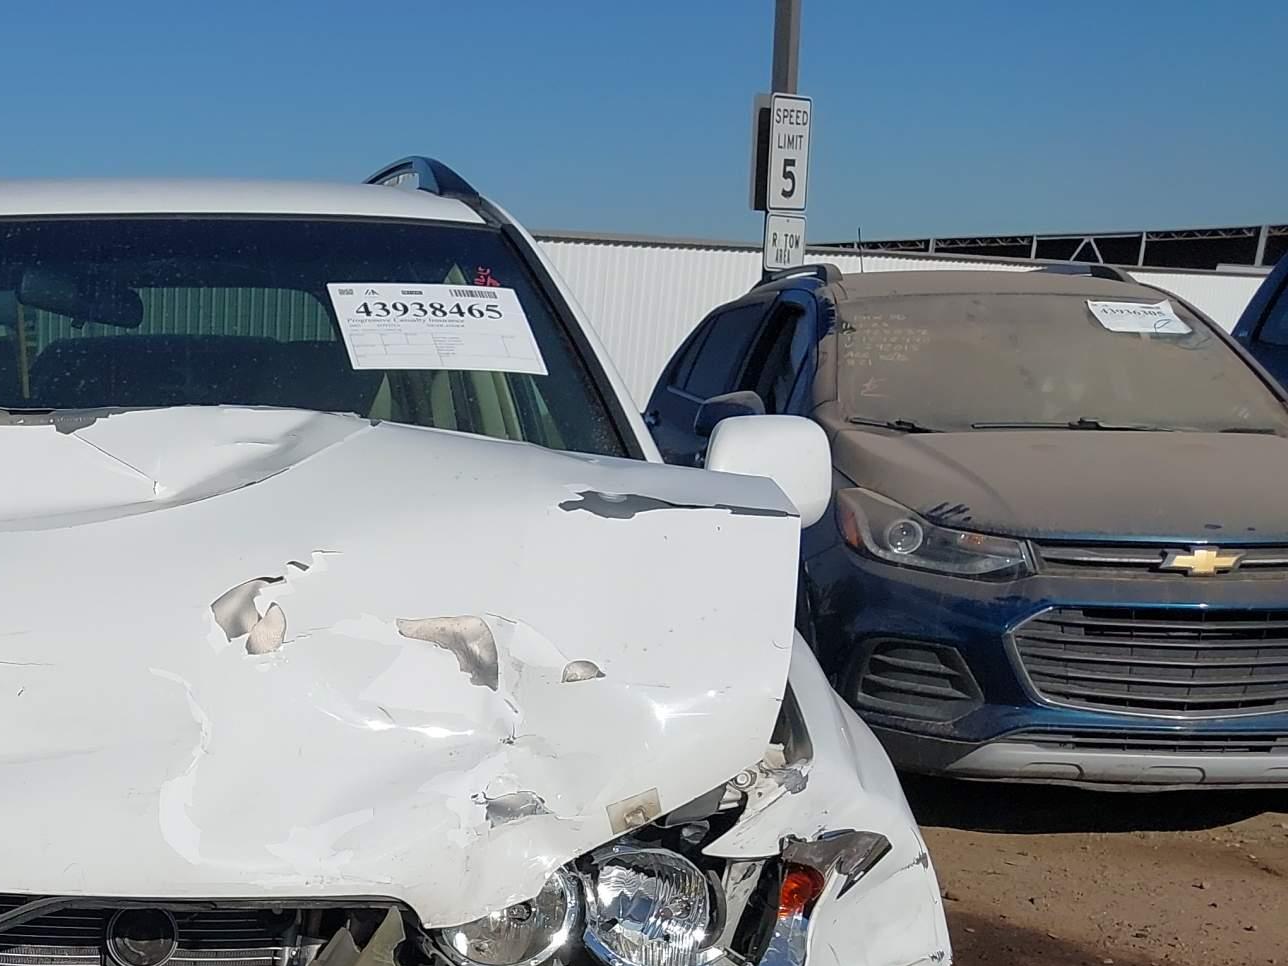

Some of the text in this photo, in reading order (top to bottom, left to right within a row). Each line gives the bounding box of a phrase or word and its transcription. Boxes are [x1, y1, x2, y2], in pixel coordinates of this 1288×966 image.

[775, 108, 808, 126] SPEED
[777, 133, 804, 150] LIMIT
[781, 158, 796, 198] 5
[784, 233, 801, 249] TOW
[775, 248, 791, 265] AREA
[355, 301, 503, 320] 43938465
